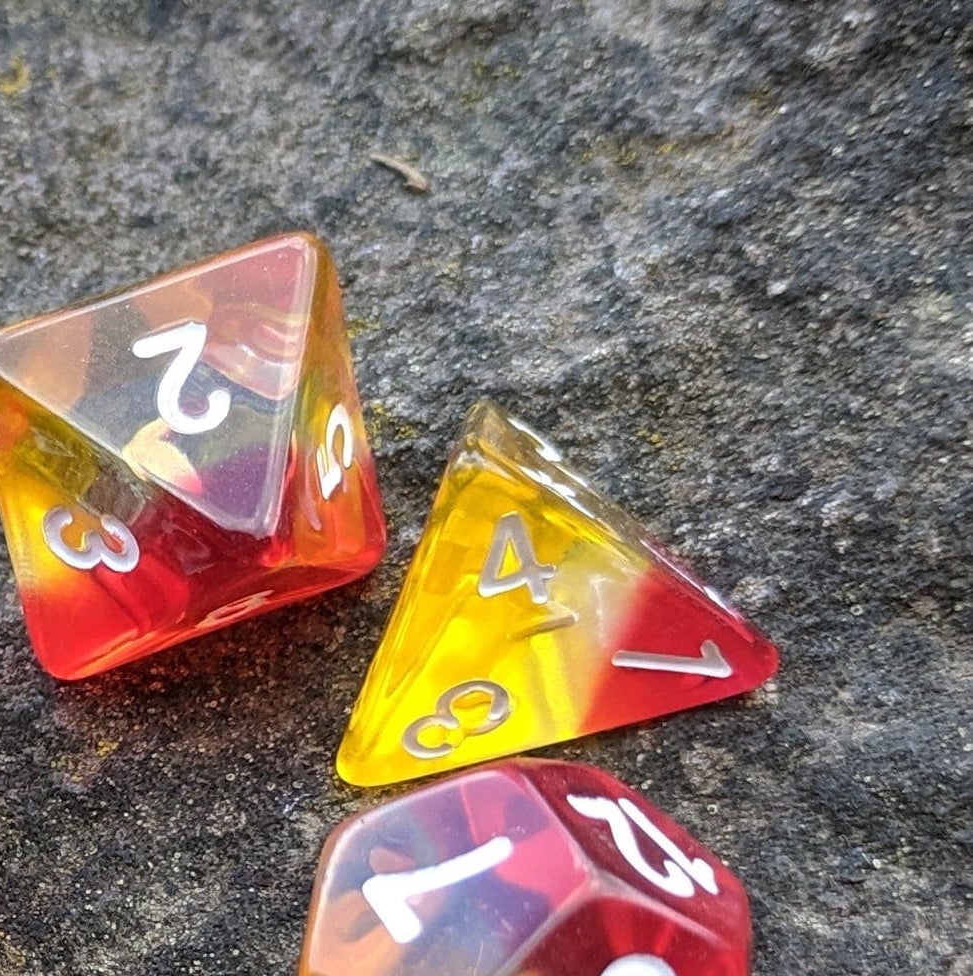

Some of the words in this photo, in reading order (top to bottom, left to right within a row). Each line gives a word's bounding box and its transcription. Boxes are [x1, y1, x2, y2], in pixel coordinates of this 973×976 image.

[133, 320, 231, 435] 2
[43, 505, 140, 572] 3
[477, 511, 556, 604] 4
[566, 794, 719, 898] 12
